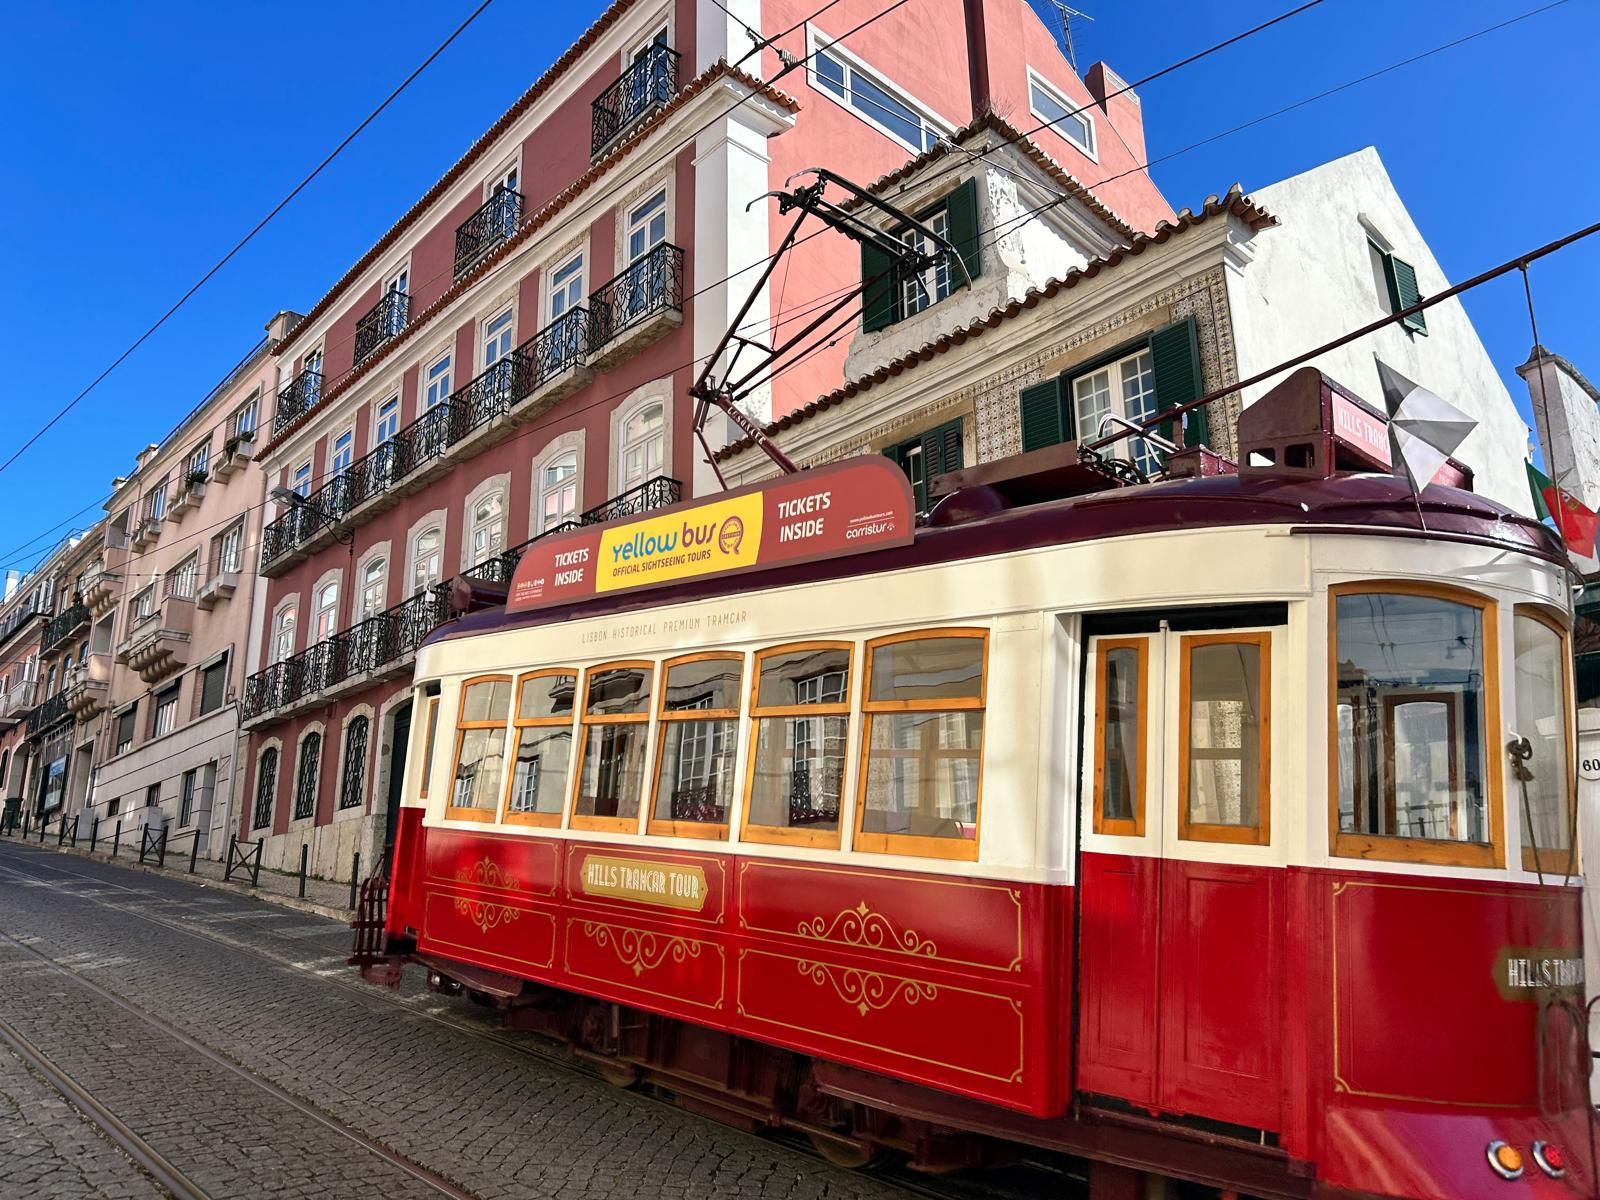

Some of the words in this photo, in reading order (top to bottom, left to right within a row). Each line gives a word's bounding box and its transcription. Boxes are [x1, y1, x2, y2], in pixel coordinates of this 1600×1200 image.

[1337, 407, 1361, 437] HILLS
[777, 491, 832, 519] TICKETS
[612, 531, 678, 563] yellow
[681, 521, 717, 548] bus
[779, 517, 825, 543] INSIDE
[846, 522, 887, 539] carristur
[554, 547, 590, 568] TICKETS
[612, 564, 640, 577] OFFICIAL
[641, 555, 686, 572] SIGHTSEEING
[687, 549, 712, 563] TOURS
[554, 568, 584, 587] INSIDE
[582, 630, 607, 644] LISBON
[612, 623, 657, 640] HISTORICAL
[663, 618, 700, 633] PREMIUM
[707, 611, 747, 626] TRAMCAR
[587, 863, 618, 888] HILLS
[620, 866, 666, 894] TRAMCAR
[669, 872, 699, 899] TOUR
[1508, 958, 1551, 988] HILLS
